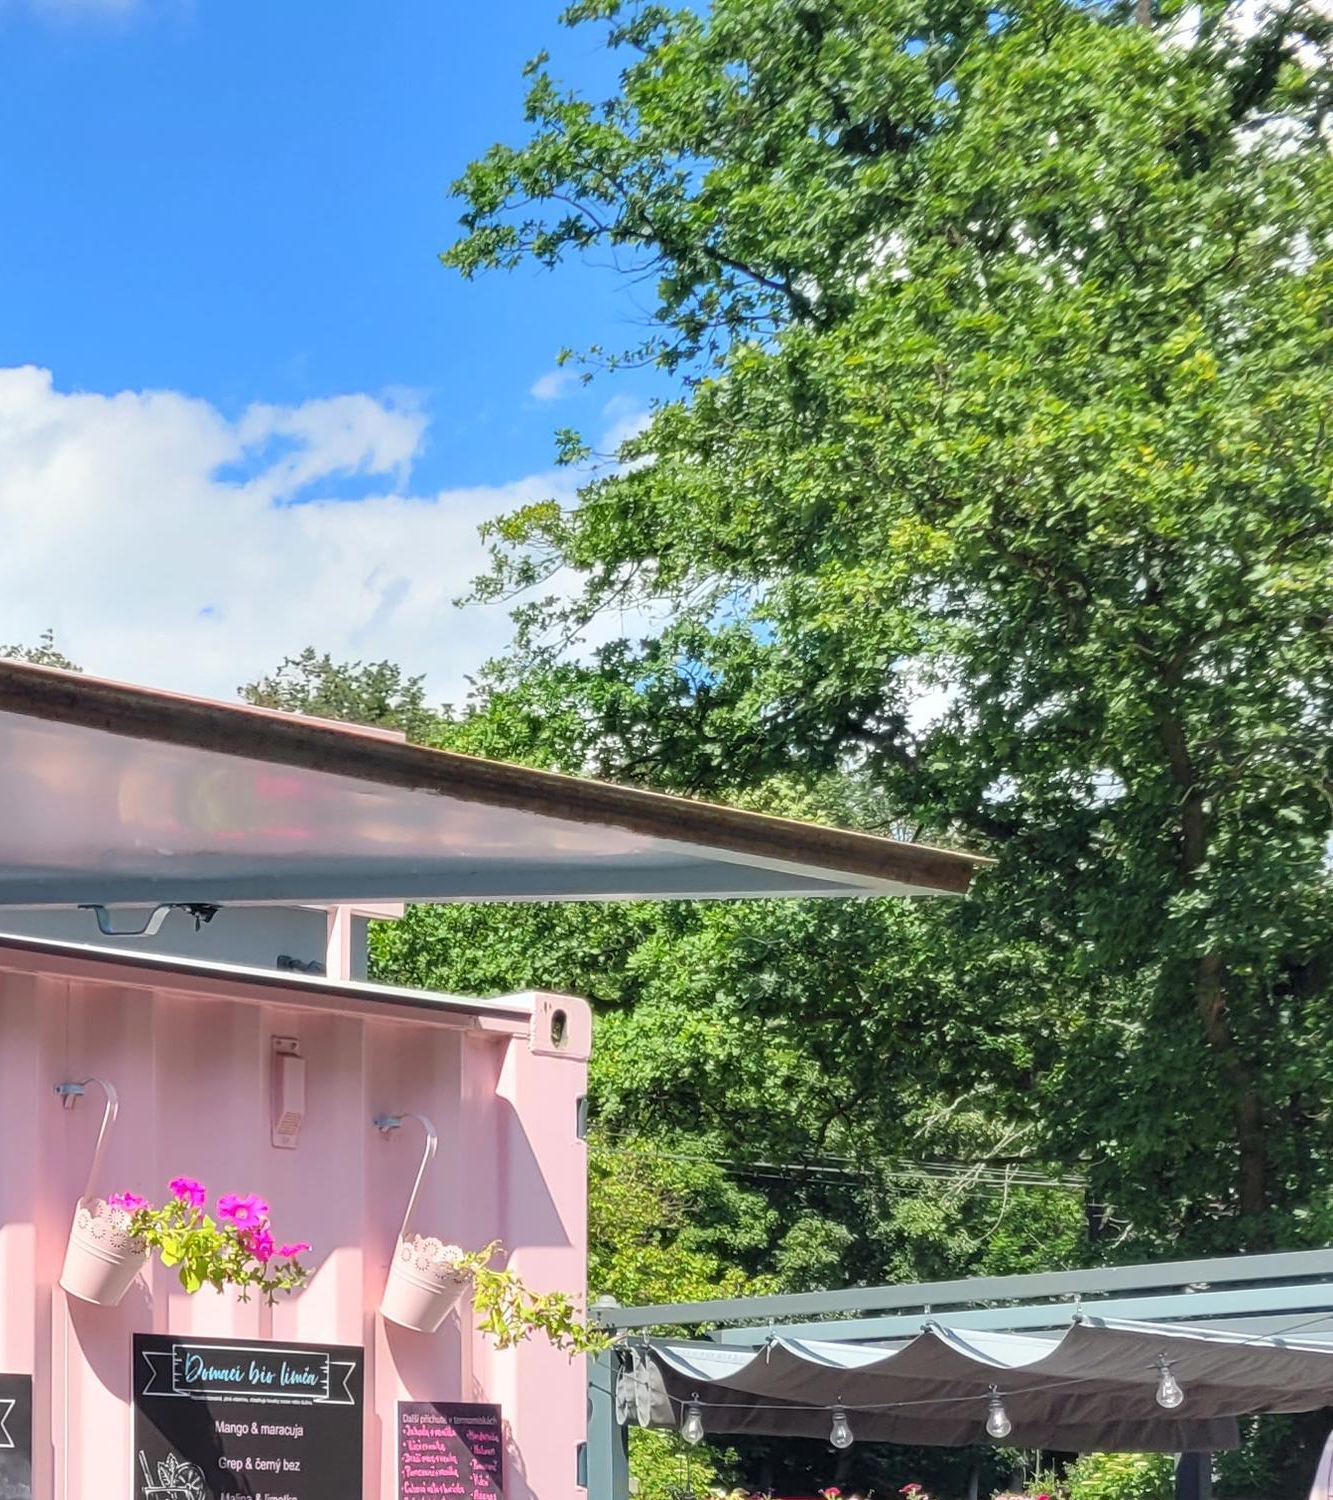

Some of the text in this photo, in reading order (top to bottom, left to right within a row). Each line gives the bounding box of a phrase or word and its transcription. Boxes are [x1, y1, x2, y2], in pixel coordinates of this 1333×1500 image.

[247, 1360, 276, 1386] bio
[215, 1420, 304, 1440] Mango & maracuja
[217, 1456, 301, 1474] Grep & černý bez
